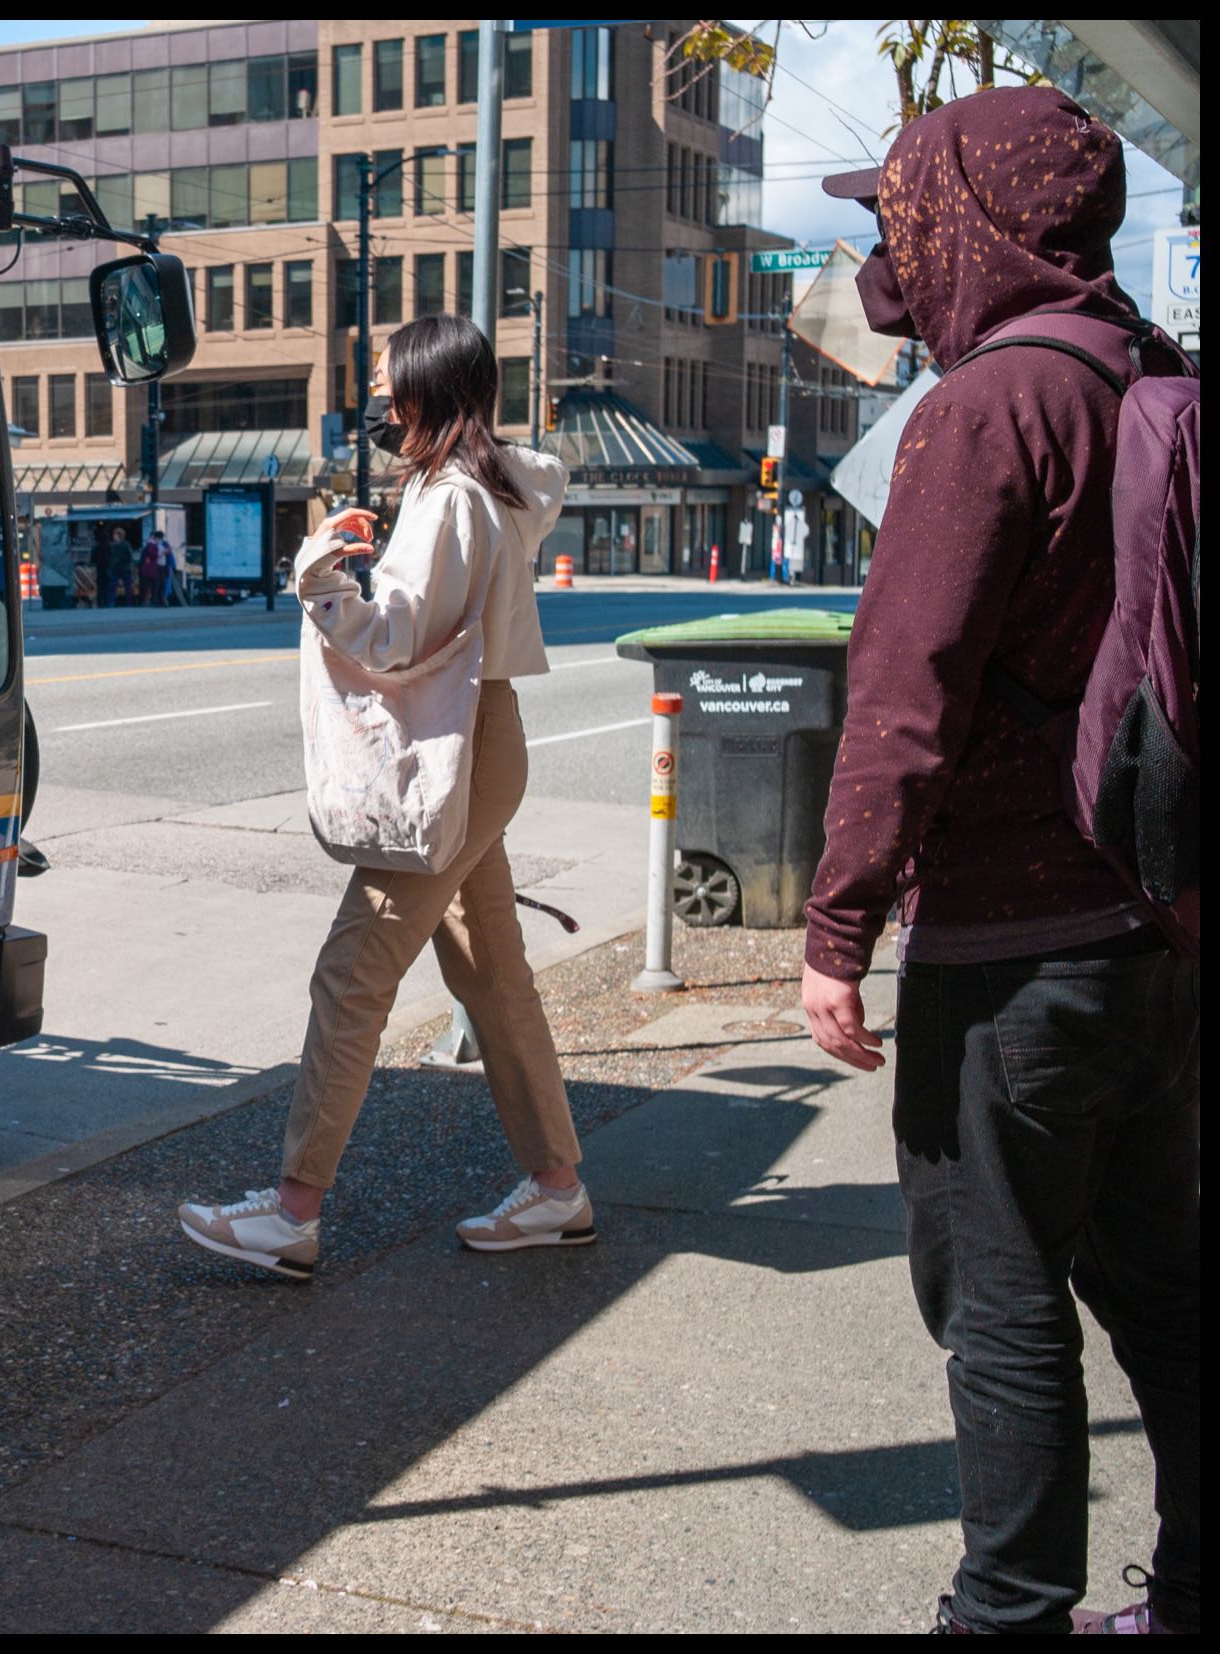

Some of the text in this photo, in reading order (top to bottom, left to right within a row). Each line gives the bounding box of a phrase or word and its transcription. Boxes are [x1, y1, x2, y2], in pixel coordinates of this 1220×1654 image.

[761, 252, 829, 267] W Broadw
[1173, 308, 1200, 320] EAS
[696, 684, 741, 693] VANCOUVER
[700, 701, 790, 712] vancouver.ca
